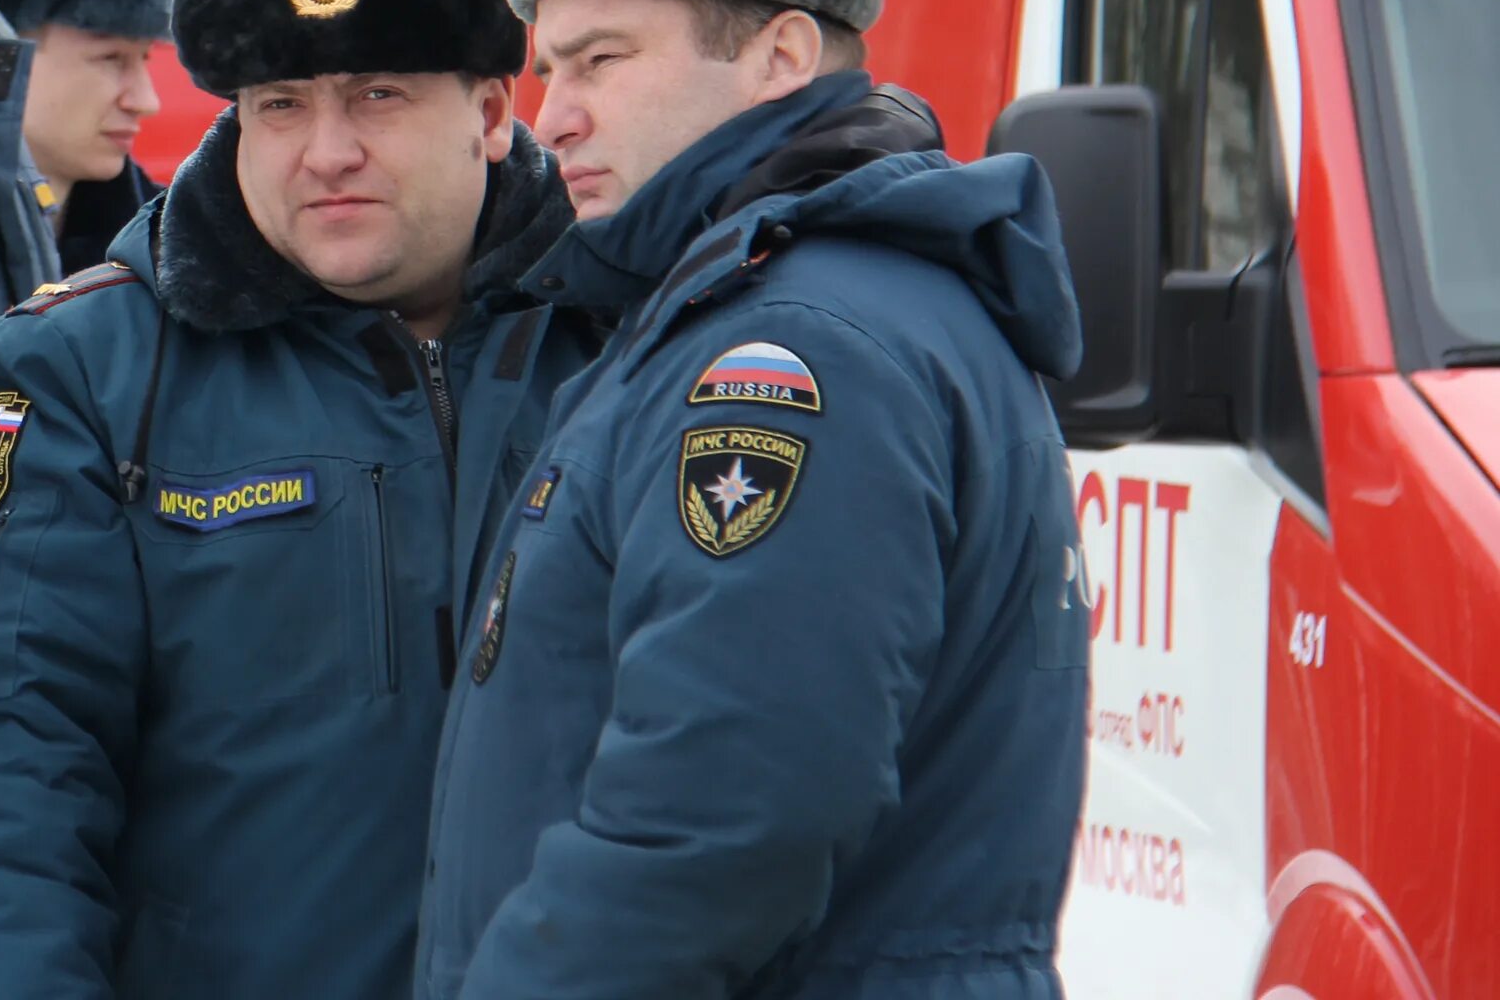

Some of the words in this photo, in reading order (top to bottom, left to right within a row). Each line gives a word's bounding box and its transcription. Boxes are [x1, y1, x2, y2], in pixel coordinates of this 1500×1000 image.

[713, 382, 793, 401] RUSSIA
[690, 432, 727, 453] МЧС
[728, 432, 798, 460] РОССИИ
[160, 489, 208, 521] МЧС
[212, 479, 302, 519] РОССИИ
[1288, 610, 1328, 669] 431
